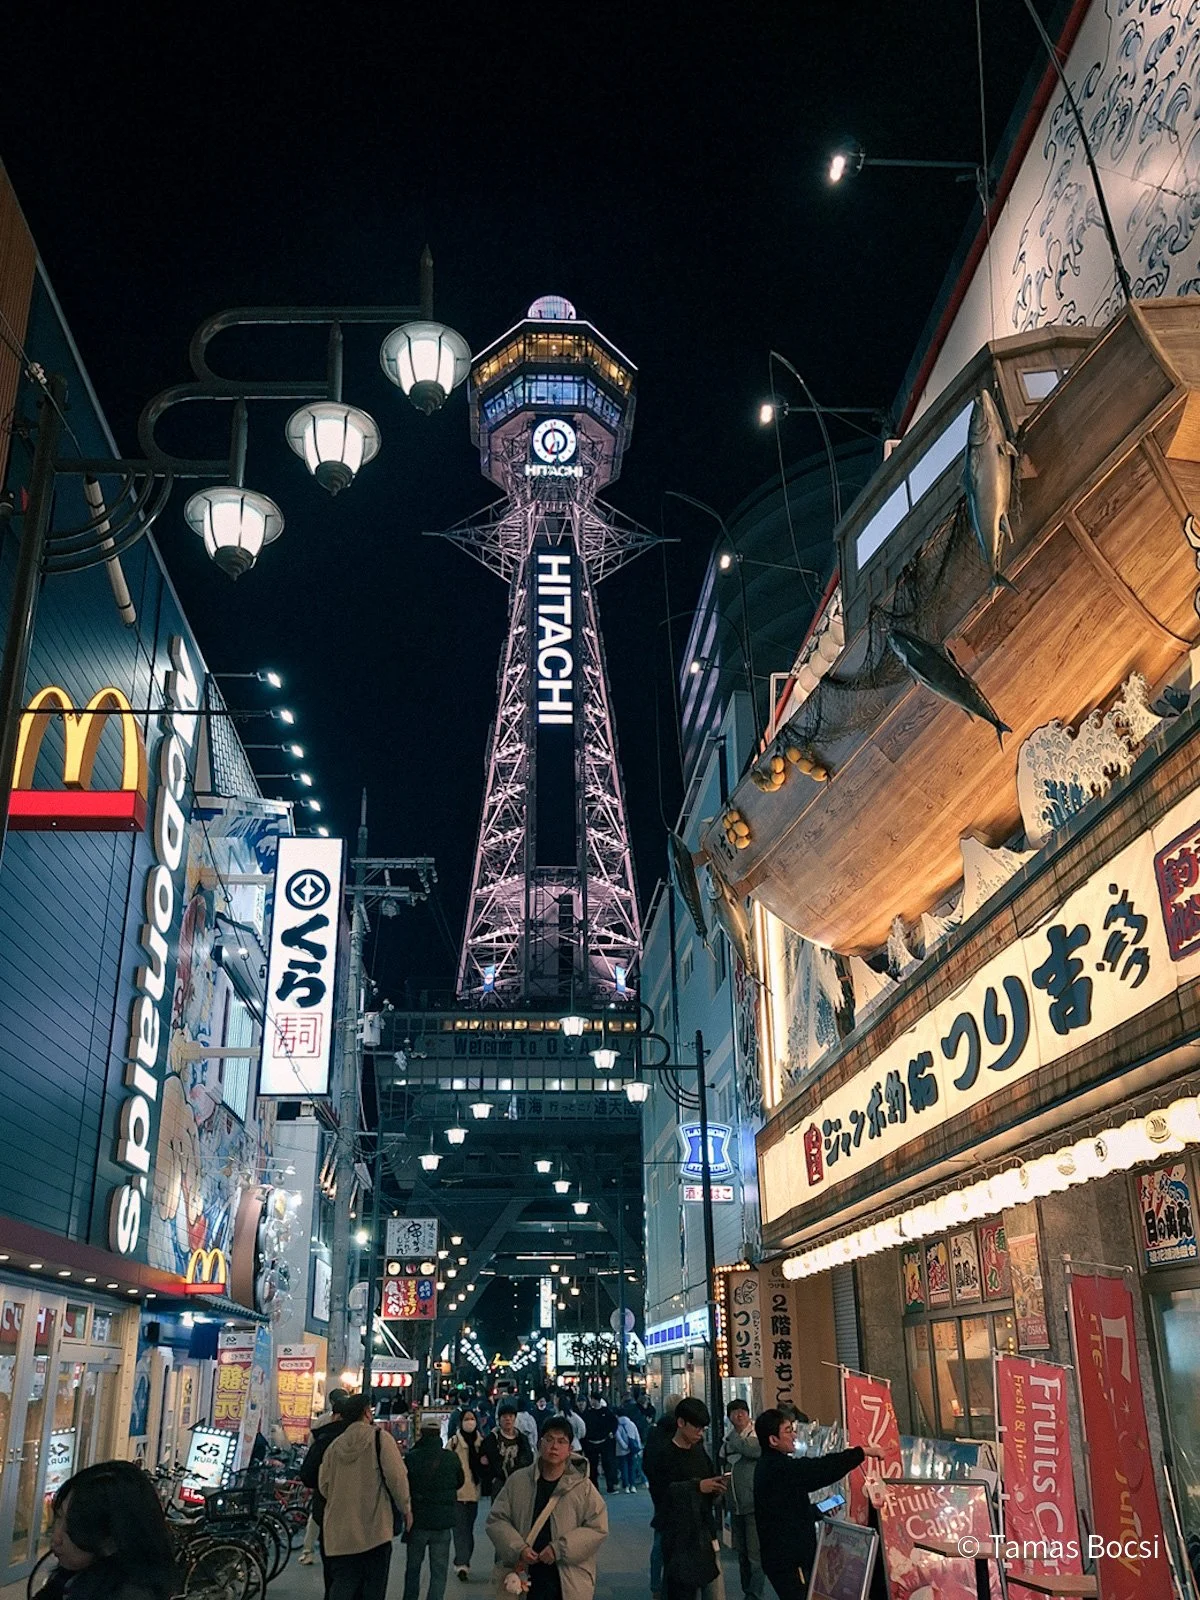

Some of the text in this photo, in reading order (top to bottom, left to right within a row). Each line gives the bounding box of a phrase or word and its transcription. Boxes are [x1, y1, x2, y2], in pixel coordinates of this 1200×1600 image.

[525, 463, 583, 477] HITACHI
[537, 555, 573, 725] HITACHI
[112, 637, 198, 1254] McDonald's
[275, 913, 330, 1008] くら
[941, 923, 1093, 1091] つり吉
[276, 1015, 318, 1055] 寿司
[454, 1036, 512, 1055] Welcome
[521, 1036, 536, 1055] to
[733, 1310, 753, 1369] つり吉
[1014, 1420, 1026, 1431] &
[1029, 1374, 1064, 1494] Fruits
[193, 1455, 219, 1466] KURA
[196, 1442, 221, 1457] くら
[883, 1485, 950, 1518] Fruits
